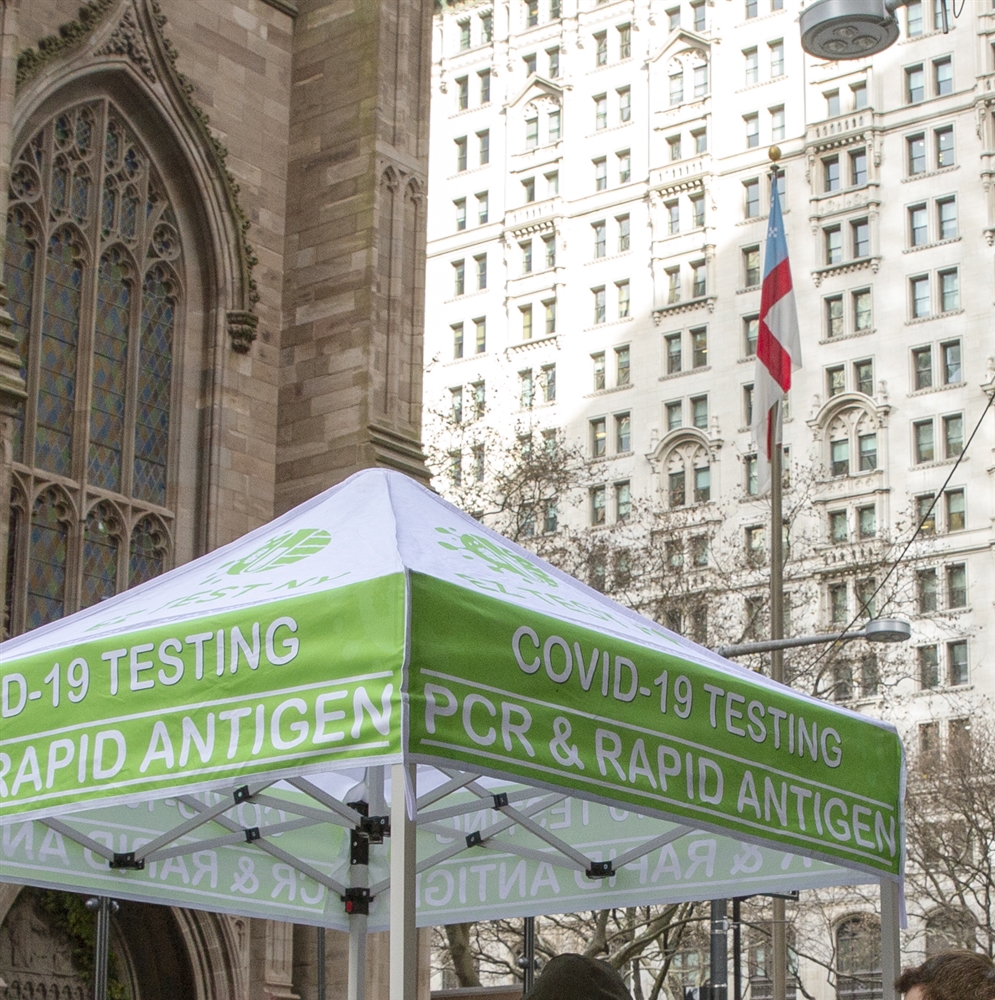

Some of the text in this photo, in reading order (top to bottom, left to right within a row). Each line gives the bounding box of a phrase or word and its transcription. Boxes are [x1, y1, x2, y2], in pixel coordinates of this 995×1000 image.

[101, 616, 299, 696] TESTING
[511, 625, 842, 768] COVID-19 TESTING
[139, 683, 394, 773] ANTIGEN
[424, 682, 897, 858] PCR & RAPID ANTIGEN
